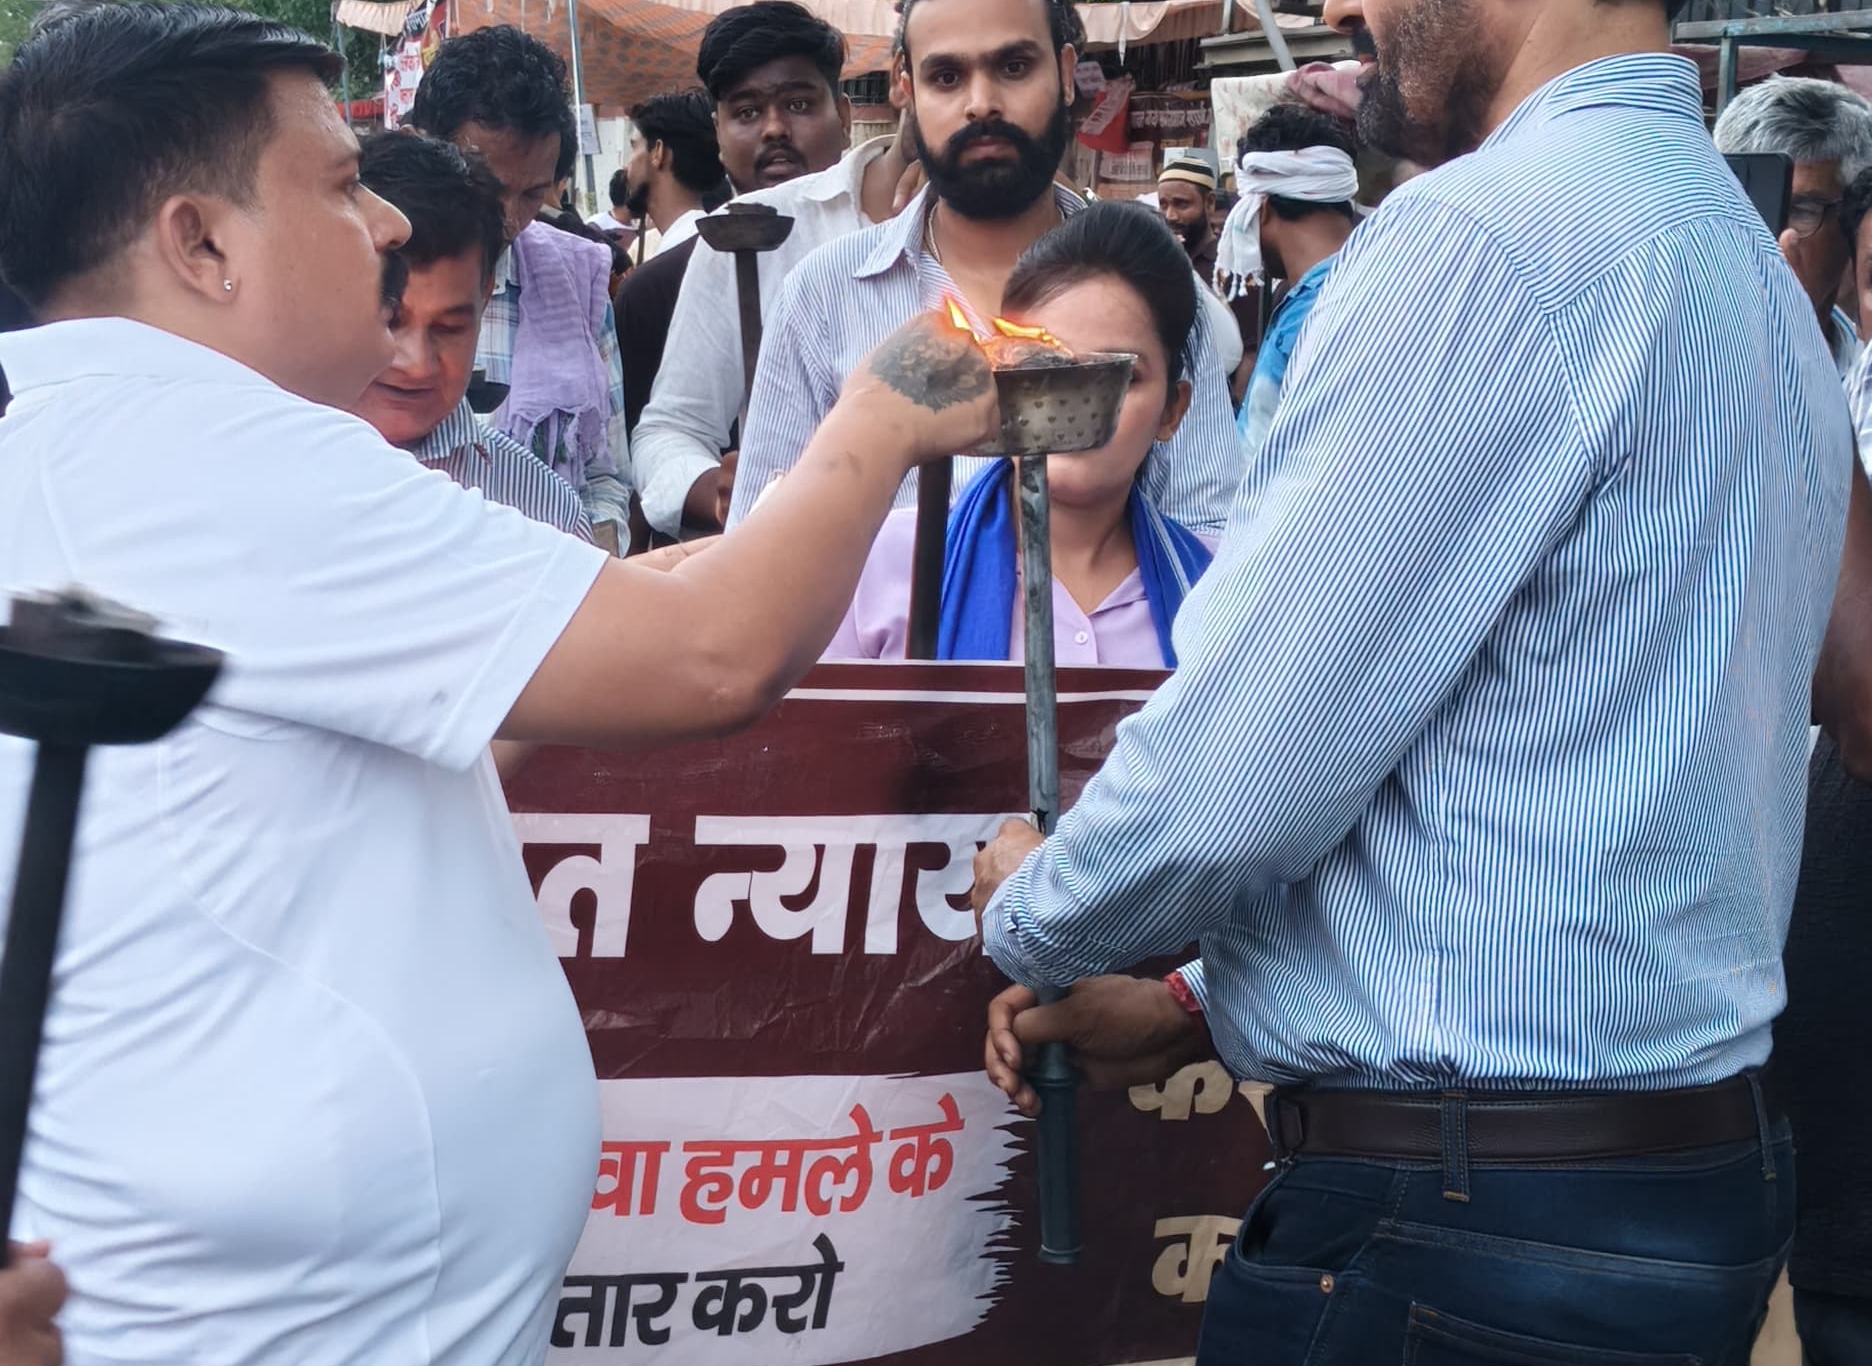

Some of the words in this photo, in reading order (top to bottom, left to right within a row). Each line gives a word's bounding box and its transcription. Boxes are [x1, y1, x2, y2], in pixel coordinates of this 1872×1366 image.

[680, 1103, 883, 1225] हमले
[889, 1092, 966, 1198] के
[691, 1232, 846, 1336] करो
